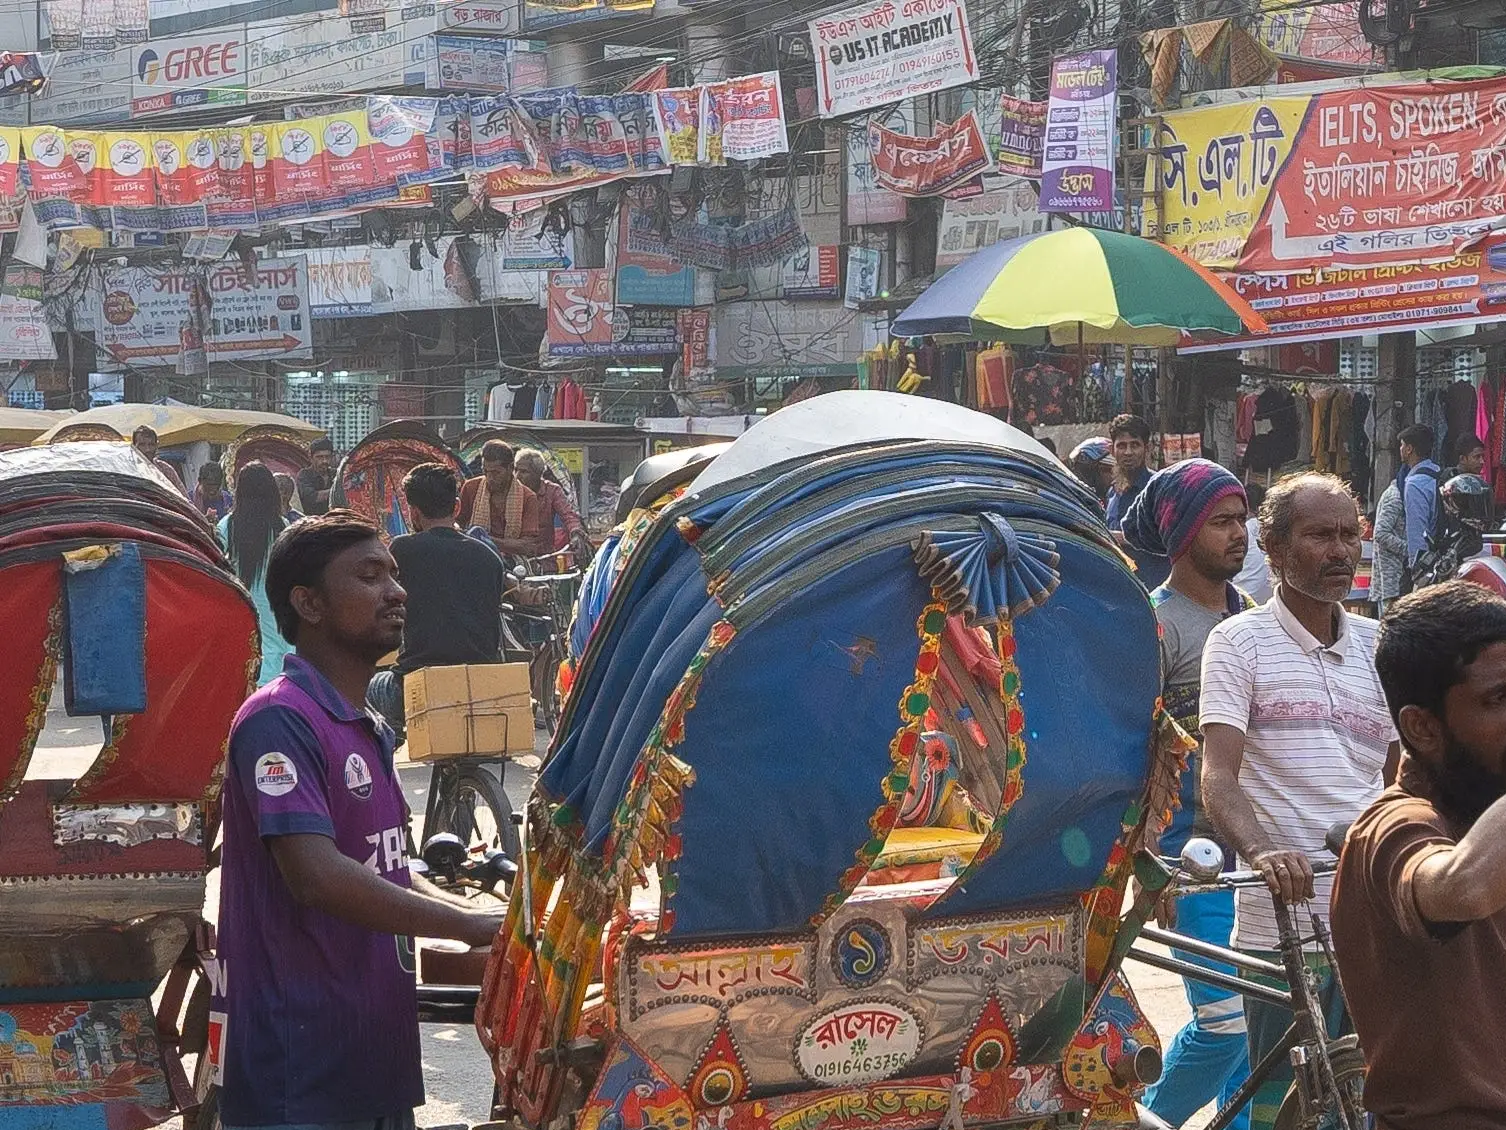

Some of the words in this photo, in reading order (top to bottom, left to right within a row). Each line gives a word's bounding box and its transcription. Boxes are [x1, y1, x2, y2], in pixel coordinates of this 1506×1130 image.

[843, 39, 866, 63] US
[866, 35, 881, 57] IT
[882, 13, 953, 53] ACADEMY
[165, 41, 239, 82] GREE
[1319, 101, 1383, 150] IELTS,
[1389, 91, 1484, 141] SPOKEN,
[1303, 152, 1390, 205] ইতালিয়ান
[1363, 206, 1403, 227] ভাষা
[1408, 198, 1477, 223] শেখানো
[1360, 229, 1417, 250] গলির
[729, 321, 849, 367] ঔষধ
[922, 918, 1070, 967] ভরসা
[811, 1009, 904, 1053] রাসেল
[813, 1050, 910, 1080] 01916463756
